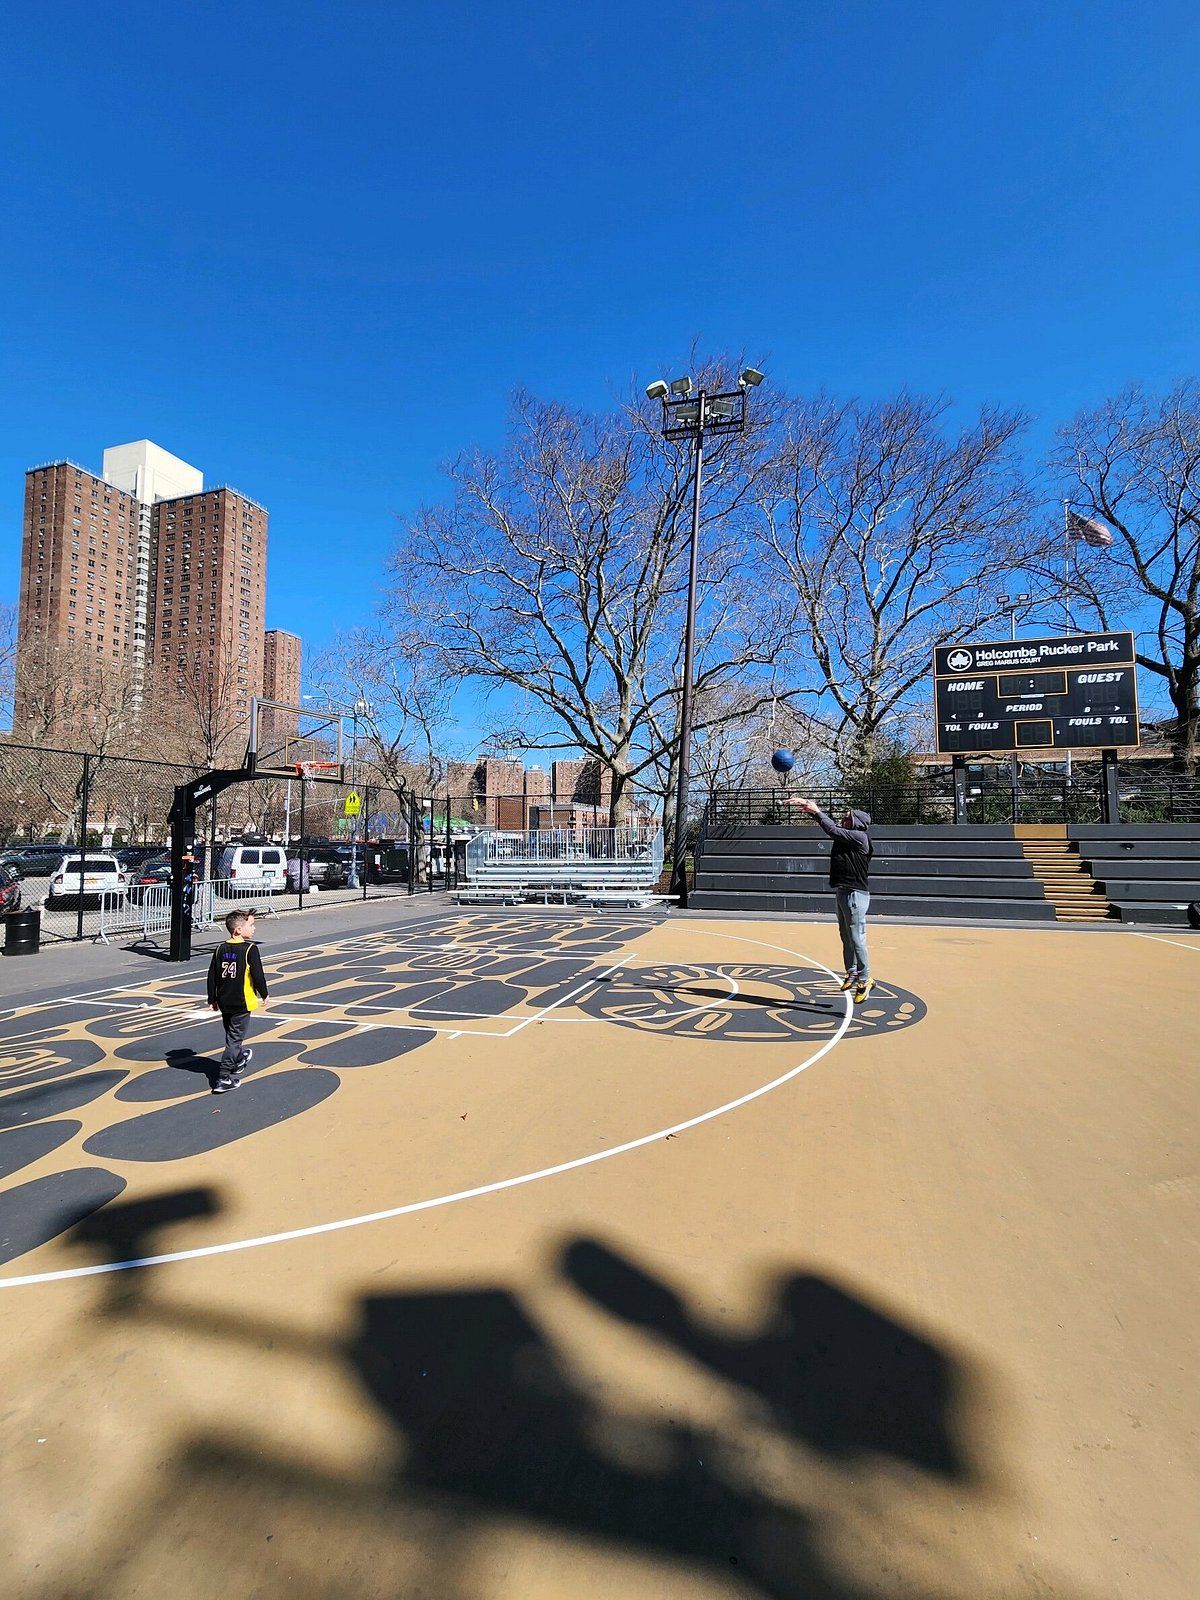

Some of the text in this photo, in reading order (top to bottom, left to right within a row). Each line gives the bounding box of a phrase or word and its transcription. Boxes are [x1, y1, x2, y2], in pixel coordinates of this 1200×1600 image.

[976, 640, 1119, 661] Holcombe Rucker Park
[1078, 672, 1124, 684] GUEST
[947, 681, 985, 692] HOME
[1005, 703, 1043, 712] PERIOD
[1068, 716, 1129, 726] FOULS TOL
[945, 722, 999, 732] TOL FOULS
